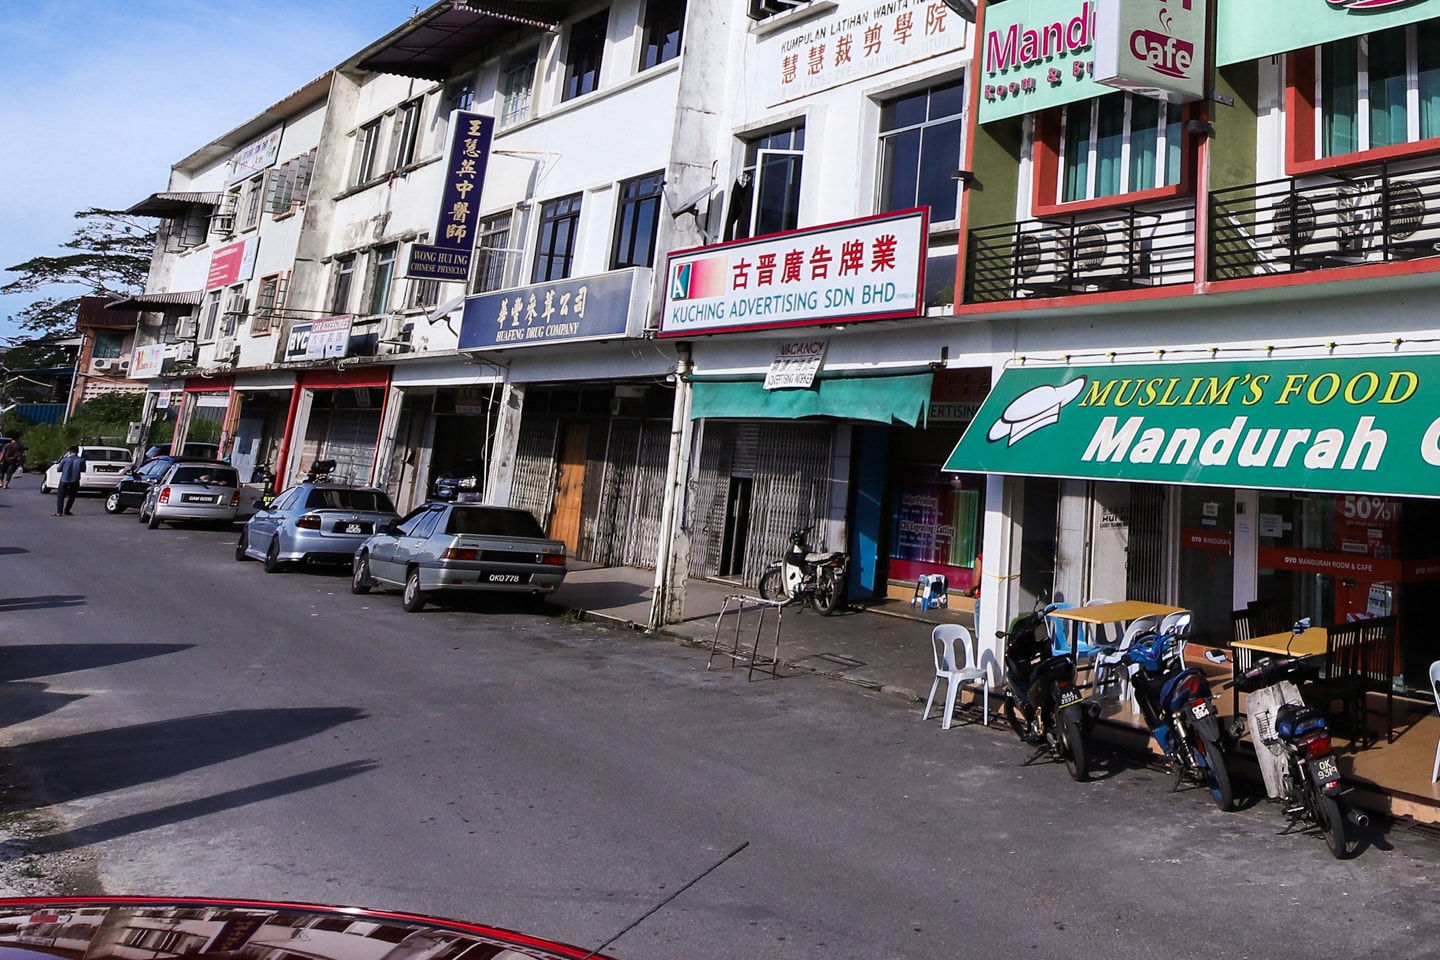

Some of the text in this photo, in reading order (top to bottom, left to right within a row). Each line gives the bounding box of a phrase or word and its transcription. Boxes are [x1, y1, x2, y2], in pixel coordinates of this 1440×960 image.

[781, 26, 826, 54] KUMPULAN
[830, 11, 869, 35] LATIHAN
[986, 0, 1097, 74] Mand
[1129, 29, 1193, 72] Cafe
[985, 77, 1036, 102] Room
[1047, 67, 1061, 87] &
[411, 262, 467, 275] CHINESE PHYSICIAN
[414, 250, 468, 265] WONG HUI ING
[672, 282, 896, 324] KUCHING ADVERTISING SDN BHD
[496, 322, 580, 342] HUAFENG DRUG COMPANY
[781, 341, 824, 356] VACANCY
[1077, 370, 1419, 407] MUSLIM'S FOOD
[1081, 415, 1388, 471] Mandurah
[1344, 496, 1391, 520] 50%
[1284, 556, 1297, 564] OYO
[1298, 557, 1331, 568] MANDURAH
[1332, 561, 1350, 570] ROOM
[1356, 563, 1373, 572] CAFE
